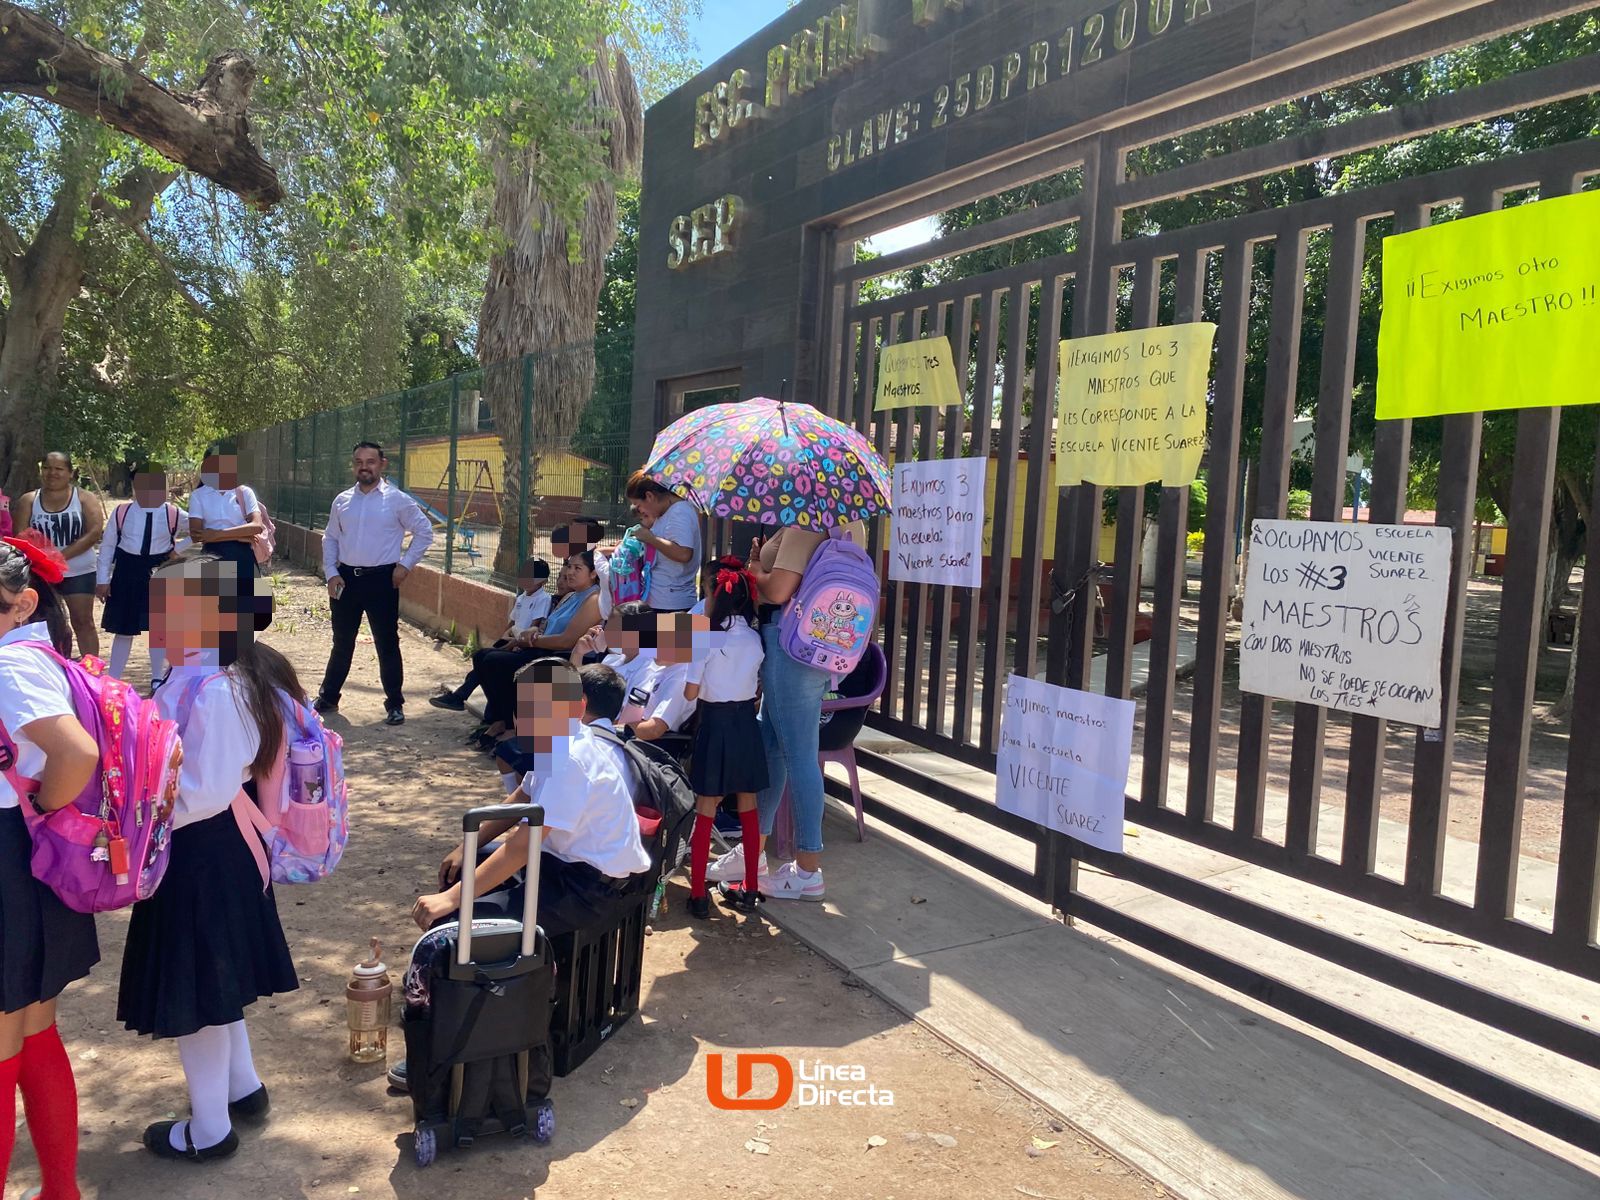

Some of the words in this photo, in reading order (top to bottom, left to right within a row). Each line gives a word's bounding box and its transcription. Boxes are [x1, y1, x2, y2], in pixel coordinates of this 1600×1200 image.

[827, 101, 920, 172] CLAVE:
[667, 193, 743, 270] SEP
[1168, 341, 1179, 357] 3
[1087, 375, 1140, 395] MAESTROS
[1150, 369, 1176, 387] QUE
[1063, 412, 1078, 426] LES
[1165, 405, 1175, 420] A
[1181, 404, 1196, 418] LA
[1060, 441, 1104, 453] ESCUELA
[1111, 436, 1160, 452] VICENTE
[956, 474, 970, 497] 3
[898, 504, 942, 520] maestros
[1375, 527, 1435, 539] ESCUELA
[1369, 549, 1424, 563] VICENTE
[1263, 563, 1289, 584] LOS
[1244, 634, 1268, 651] CON
[1272, 635, 1292, 653] DOS
[1299, 663, 1316, 683] NO
[1321, 669, 1335, 685] SE
[1310, 686, 1329, 703] LOS
[1042, 746, 1082, 762] escuela
